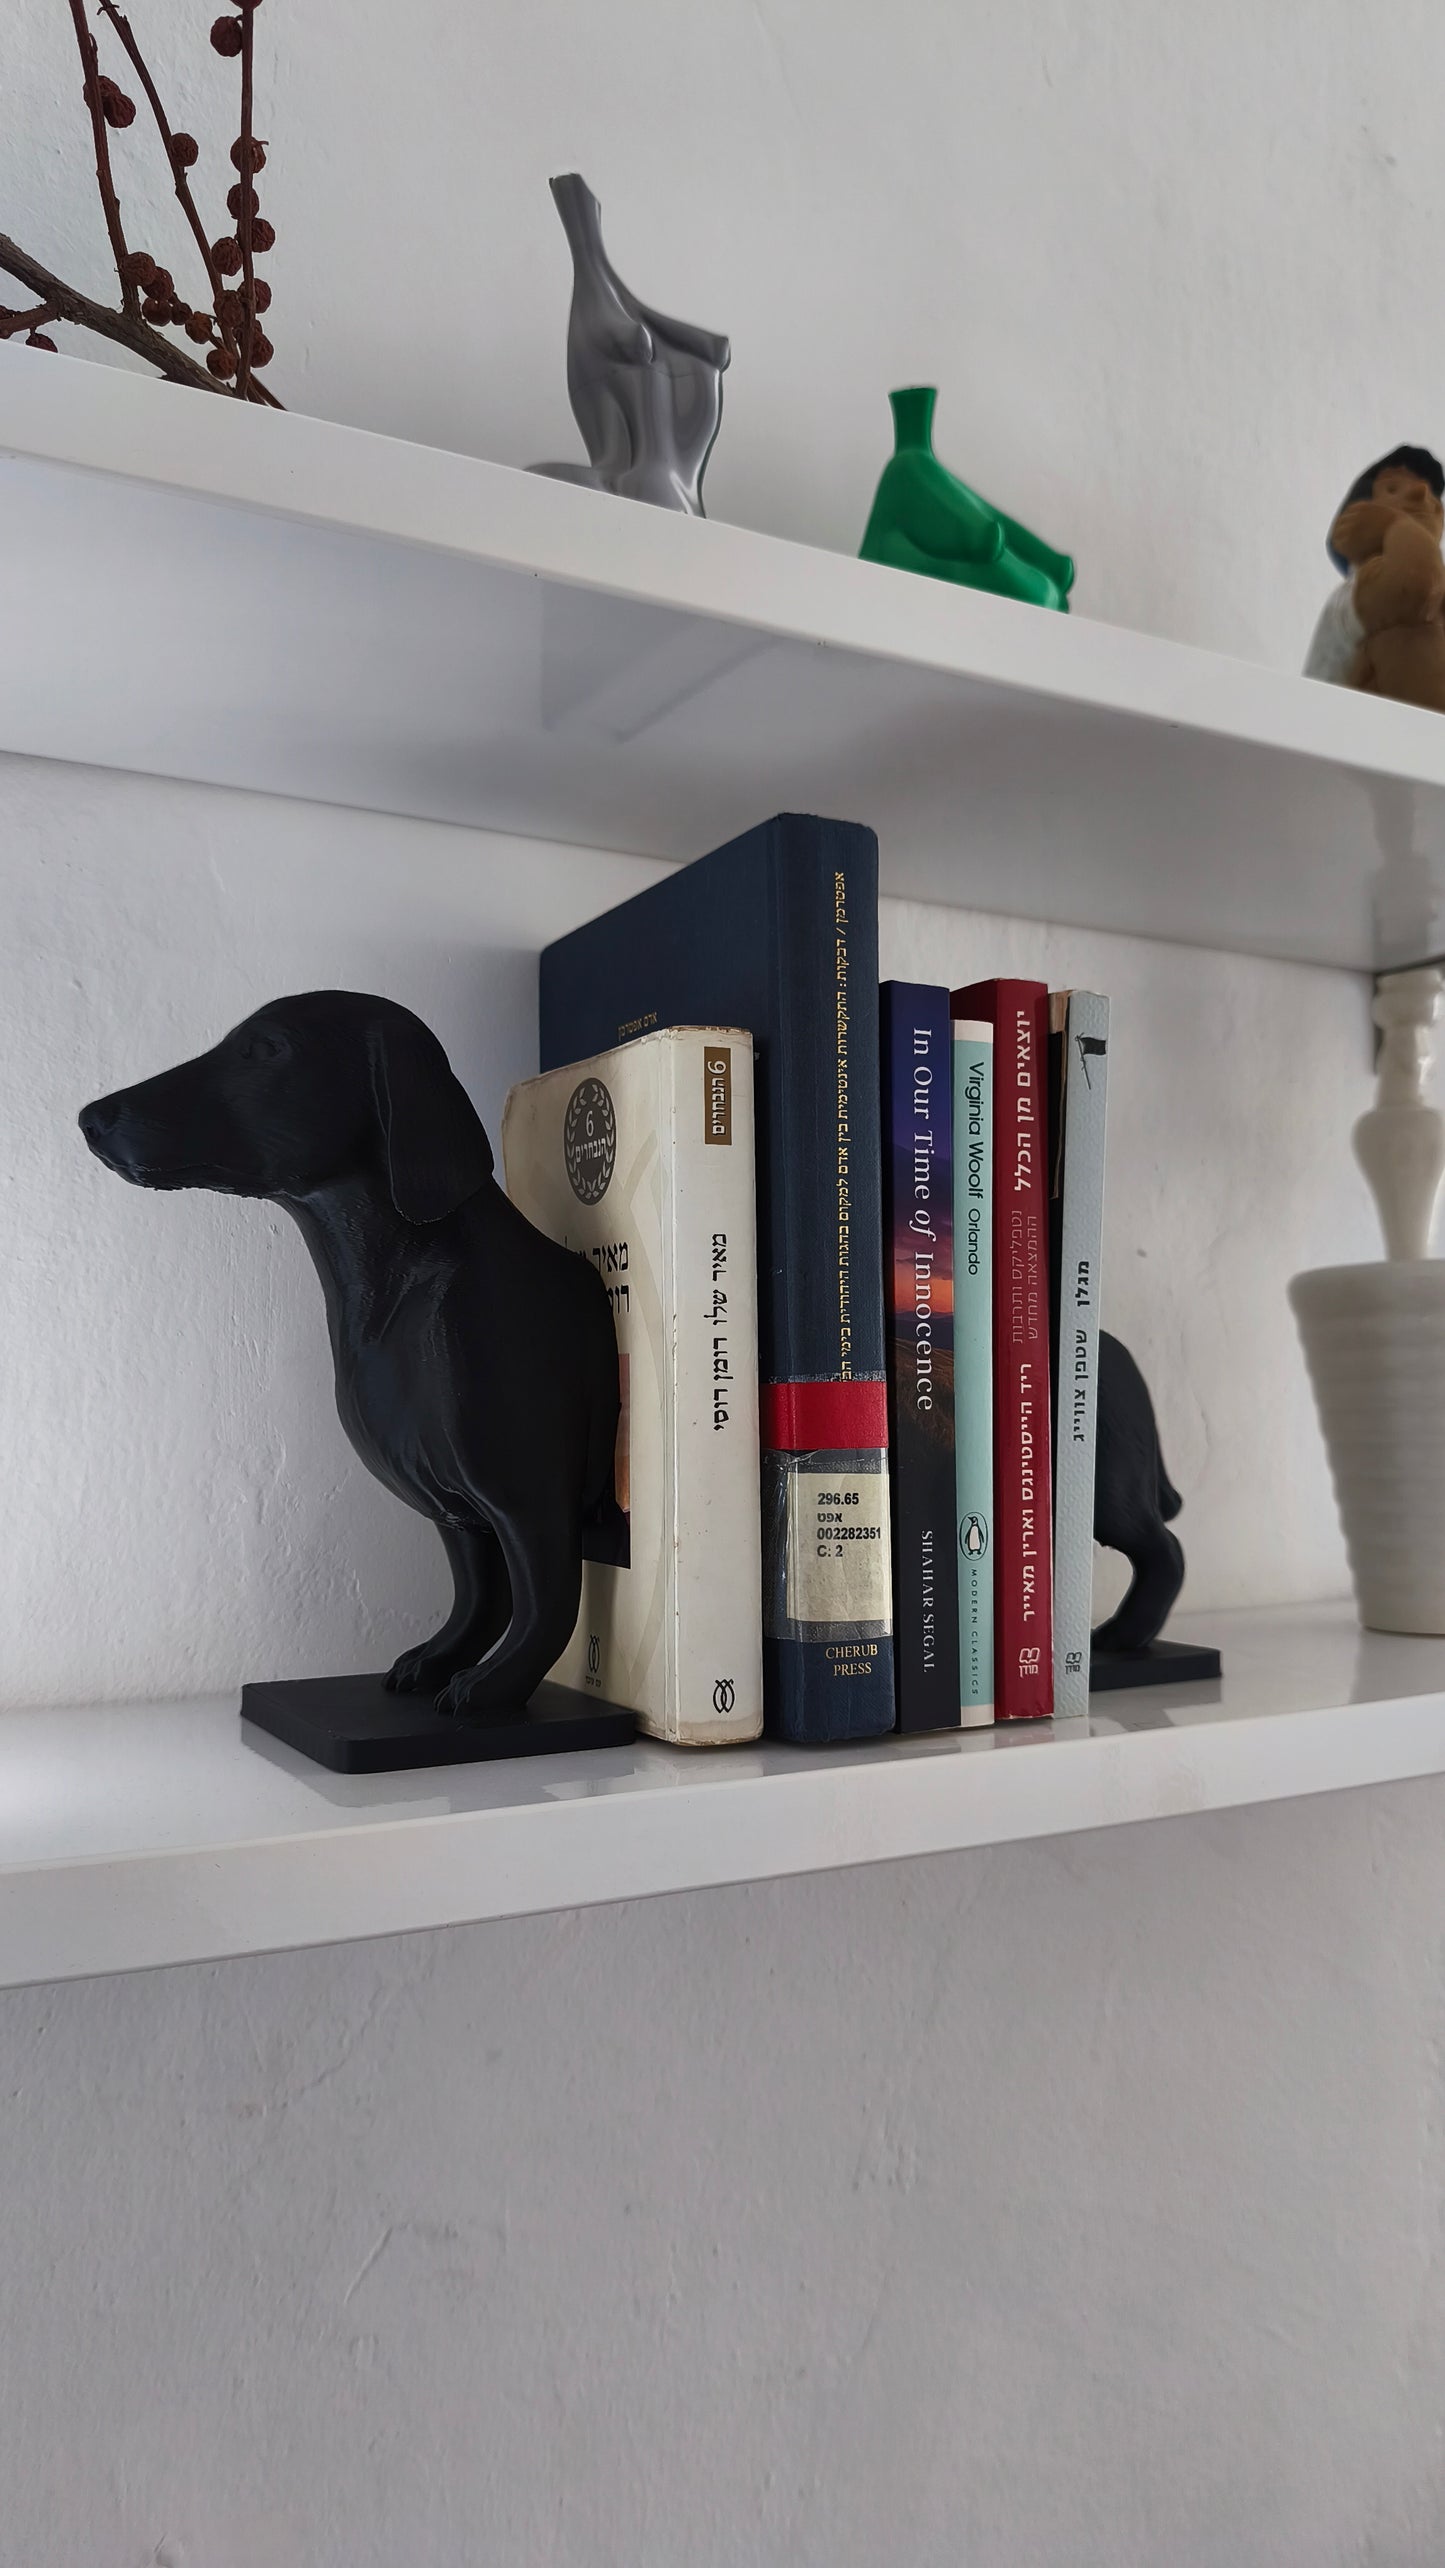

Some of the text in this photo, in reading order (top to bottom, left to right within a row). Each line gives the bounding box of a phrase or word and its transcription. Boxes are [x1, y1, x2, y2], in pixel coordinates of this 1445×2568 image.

[834, 872, 849, 924] אפטרמן
[836, 991, 849, 1055] התקשרות
[707, 1059, 727, 1136] 6 הנבחרים
[837, 1059, 848, 1120] אינטימית
[1014, 1010, 1035, 1191] יוצאים מן הכלל
[585, 1110, 595, 1137] 6
[837, 1123, 851, 1143] בין
[575, 1137, 606, 1164] הנבחרים
[838, 1147, 849, 1174] אדם
[965, 1061, 985, 1276] Virginia Woolf Orlando
[836, 1178, 851, 1221] למקום
[908, 1028, 937, 1410] In Our Time of Innocence
[838, 1225, 849, 1267] בהגות
[839, 1270, 850, 1323] היהודית
[1009, 1209, 1024, 1344] נטפליקס ותרבות
[1026, 1215, 1039, 1340] ההמצאה מחדש
[703, 1233, 733, 1431] מאיר שלו רומן רוסי
[840, 1327, 851, 1357] בימי
[1073, 1261, 1090, 1442] מגלן שטפן צווייג
[817, 1492, 860, 1505] 296.65
[817, 1512, 843, 1523] אפט
[1020, 1363, 1037, 1622] ריד הייסטינגס וארין מאייר
[816, 1526, 881, 1540] 002282351
[816, 1544, 844, 1558] C: 2
[921, 1530, 936, 1673] SHAHAR SEGAL
[825, 1644, 878, 1660] CHERUB
[970, 1568, 980, 1695] MODERN CLASSICS
[833, 1662, 873, 1676] PRESS
[1019, 1665, 1039, 1678] מודן
